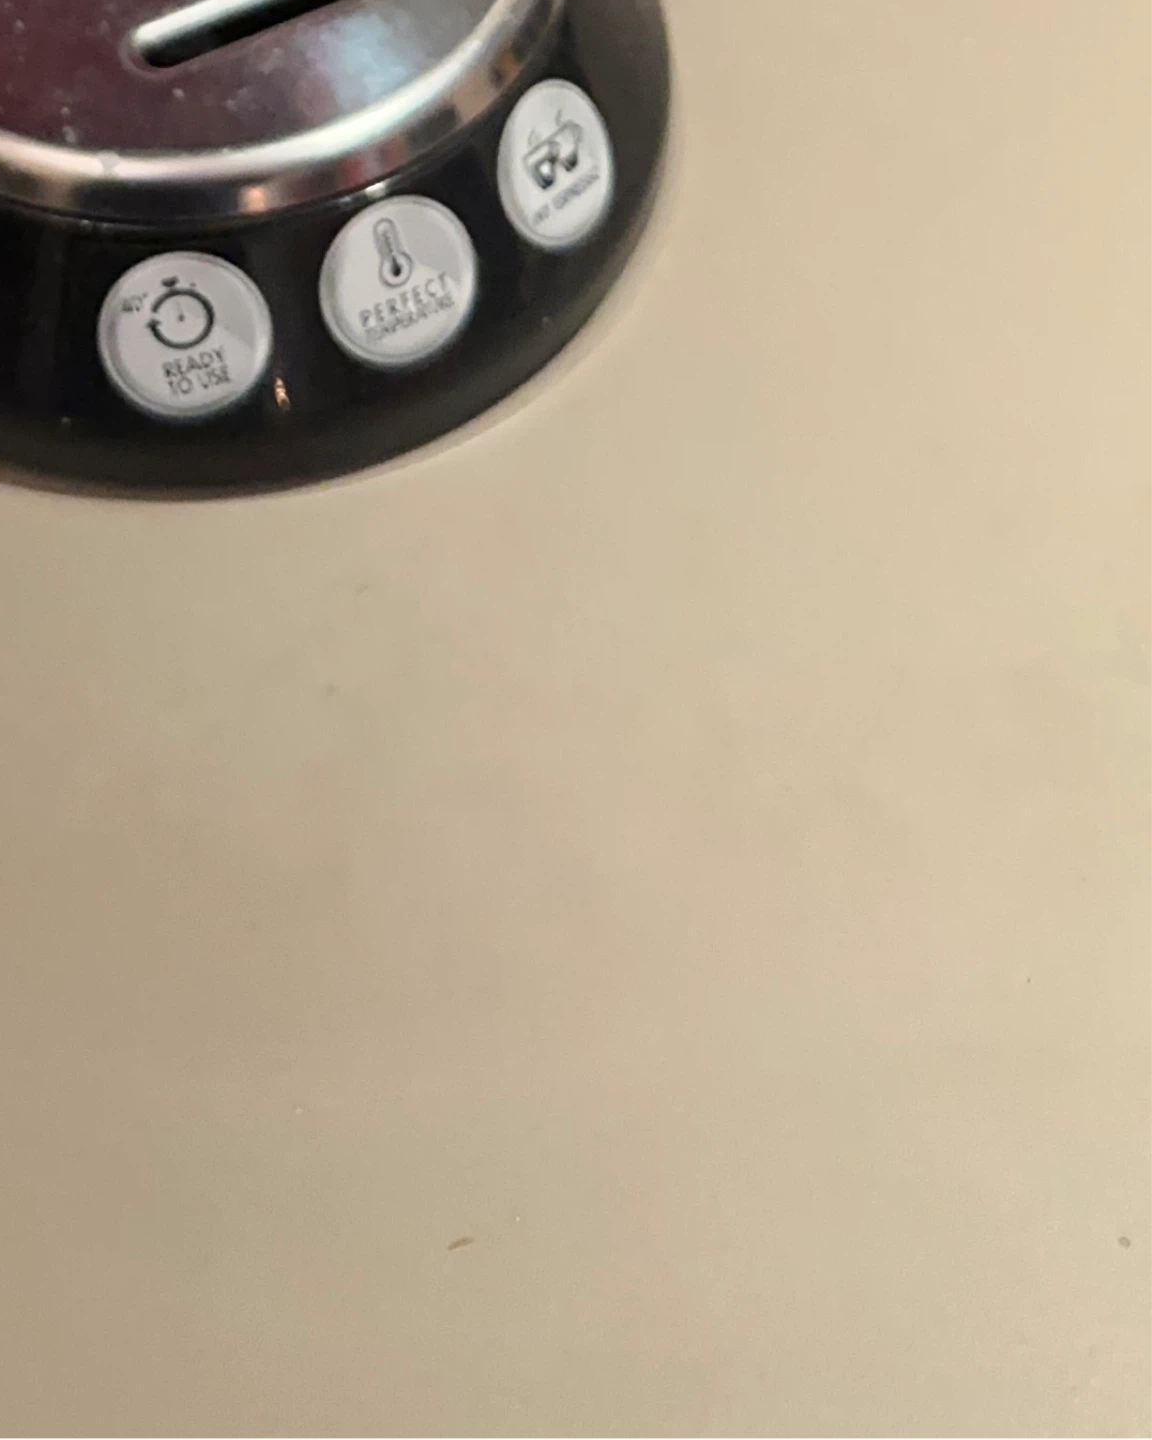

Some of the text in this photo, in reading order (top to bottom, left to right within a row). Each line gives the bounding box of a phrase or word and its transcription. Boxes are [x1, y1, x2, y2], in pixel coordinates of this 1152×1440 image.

[358, 272, 448, 327] PERFECT
[162, 346, 225, 378] READY
[167, 363, 231, 396] TO USE
